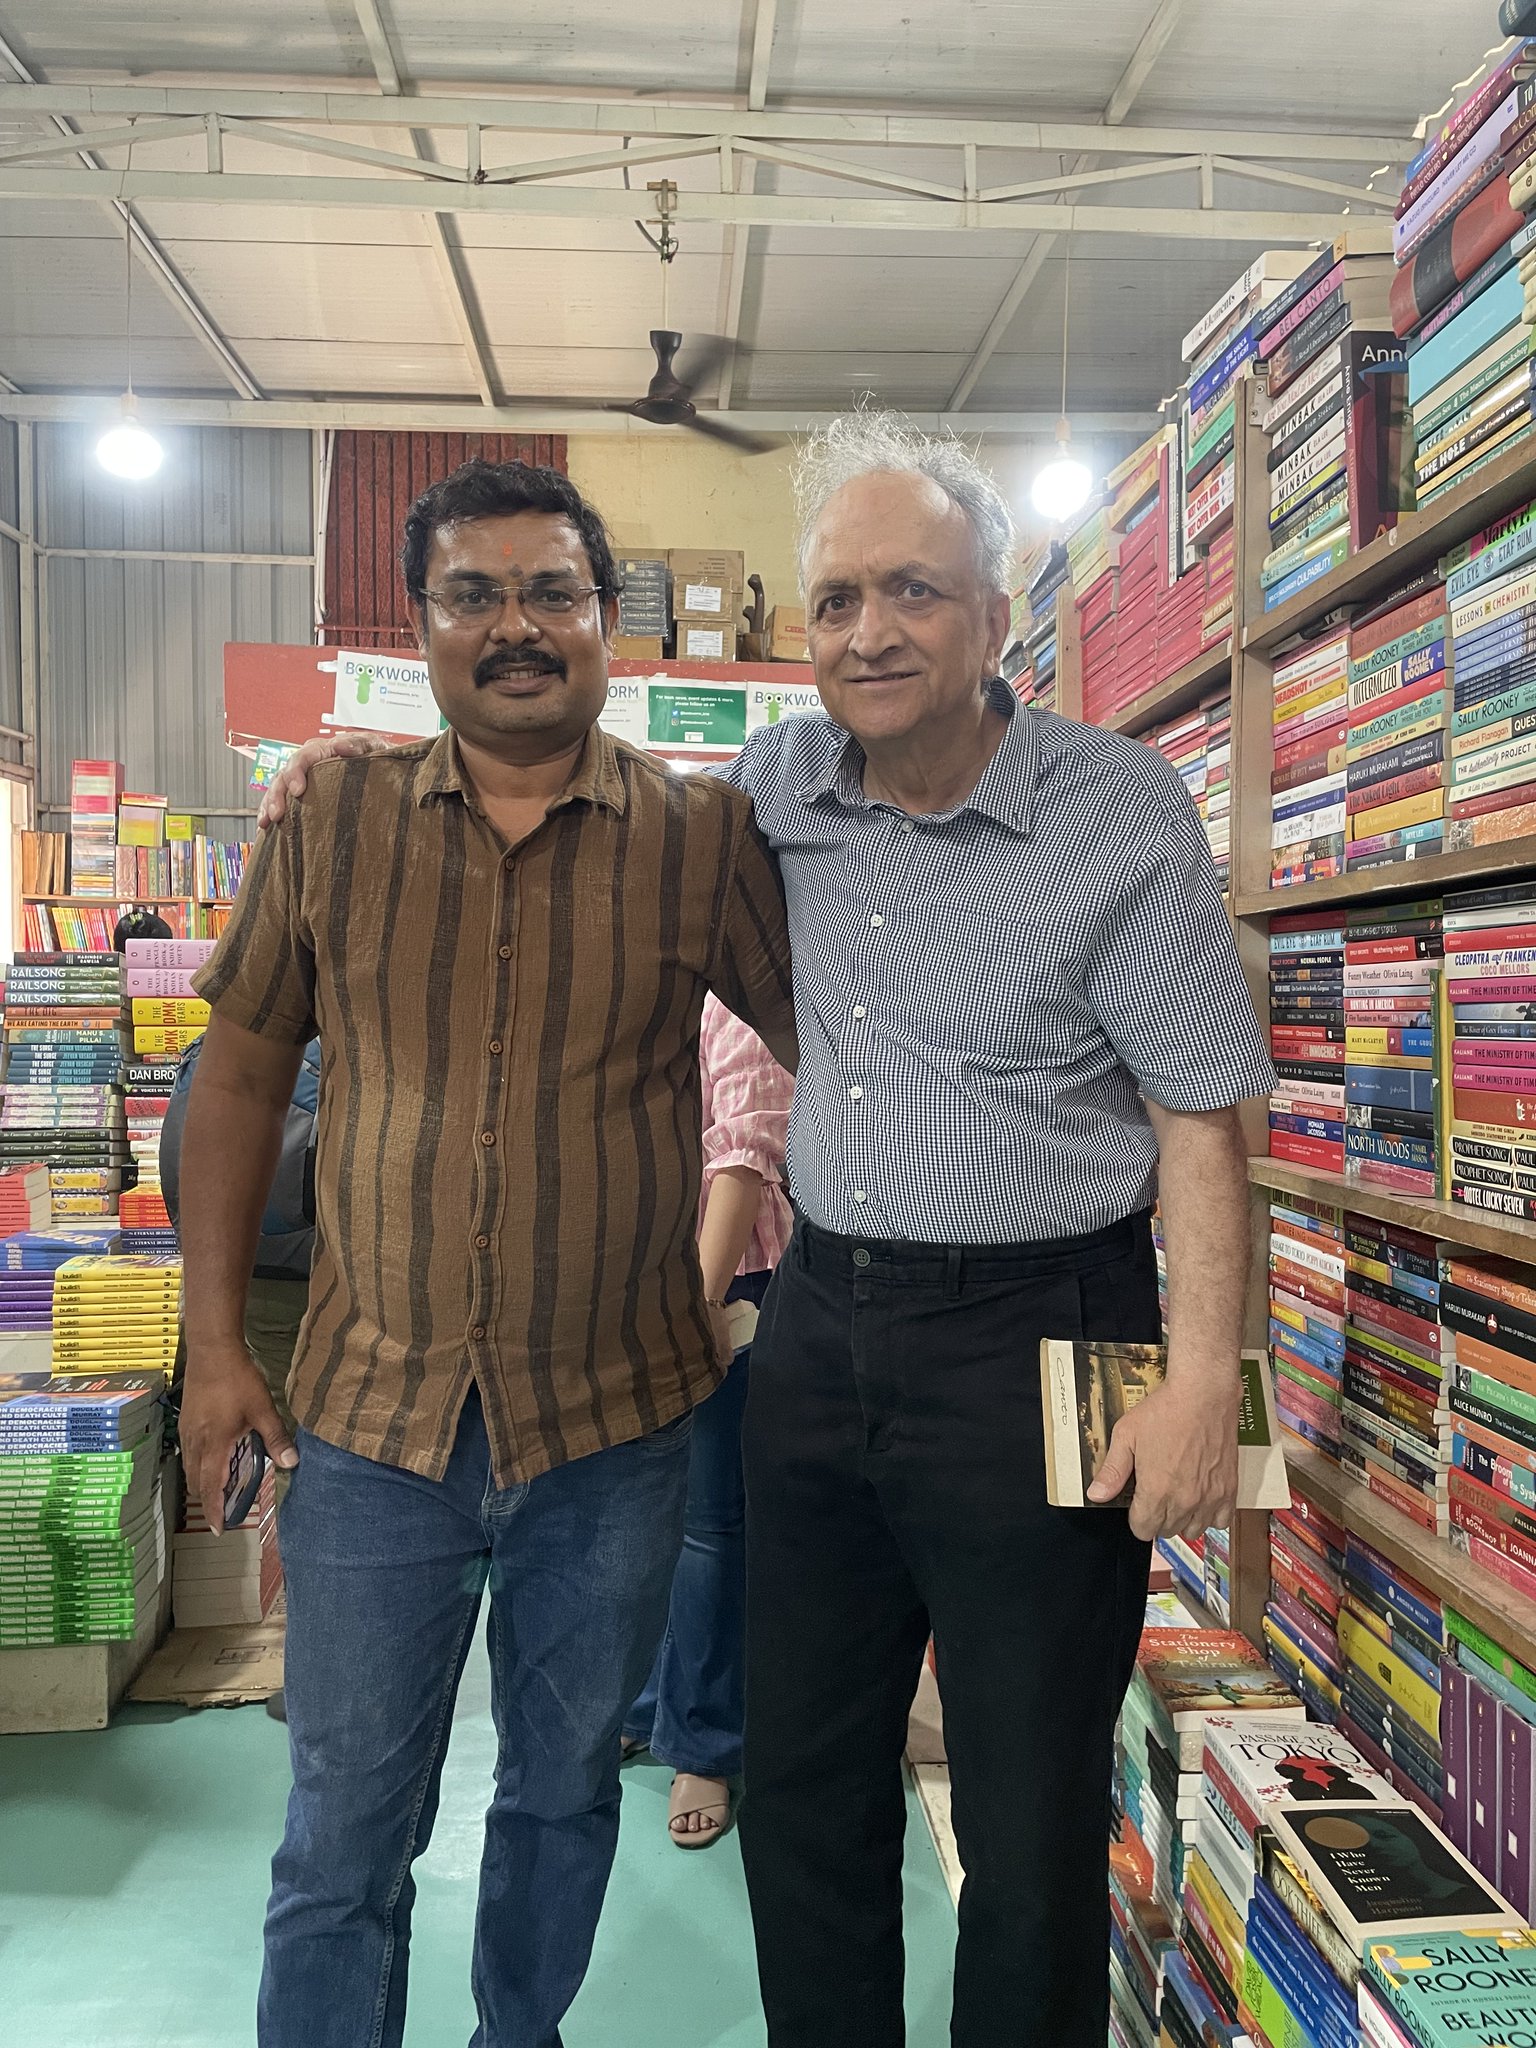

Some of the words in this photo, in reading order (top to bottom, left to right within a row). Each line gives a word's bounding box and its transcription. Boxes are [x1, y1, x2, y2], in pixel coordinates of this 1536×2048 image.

[1279, 319, 1295, 336] BEL
[1297, 279, 1331, 318] CANTO
[1469, 378, 1485, 394] Moon
[1484, 365, 1499, 381] Glow
[1499, 343, 1529, 371] Bookshop
[1280, 400, 1316, 441] MINBAK
[1277, 442, 1312, 482] MINBAK
[1419, 460, 1439, 482] THE
[1439, 437, 1466, 467] HOLE
[1278, 461, 1314, 500] MINBAK
[1187, 503, 1196, 521] BEST
[1196, 490, 1209, 511] OFFER
[1209, 478, 1220, 498] WINS
[1187, 522, 1196, 539] BEST
[1196, 510, 1209, 530] OFFER
[1209, 499, 1220, 518] WINS
[1480, 503, 1531, 549] Martyr!
[1296, 554, 1332, 587] CULPABILITY
[1451, 575, 1466, 595] EVIL
[1466, 562, 1480, 583] EYE
[1498, 539, 1515, 563] ETAF
[1517, 527, 1533, 551] RUM
[1456, 605, 1484, 629] LESSONS
[1492, 582, 1531, 611] CHEMISTRY
[1353, 659, 1371, 677] SALLY
[1371, 643, 1400, 666] ROONEY
[1404, 657, 1434, 682] ROONEY
[1407, 647, 1431, 668] SALLY
[345, 661, 429, 684] BOOKWORM
[1353, 664, 1397, 706] INTERMEZZO
[755, 691, 823, 707] BOOKWO
[1457, 708, 1480, 728] SALLY
[1481, 693, 1520, 721] ROONEY
[1351, 724, 1370, 743] SALLY
[1369, 712, 1399, 733] ROONEY
[1459, 733, 1480, 749] Richard
[1481, 726, 1509, 743] Flanagan
[1348, 765, 1369, 784] HARUKI
[1369, 756, 1399, 777] MURAKAMI
[1467, 751, 1499, 773] Authenticity
[1500, 742, 1531, 761] PROJECT
[1361, 787, 1381, 807] Naked
[1380, 781, 1401, 803] Light
[1455, 952, 1490, 967] CLEOPATRA
[1480, 964, 1498, 976] COCO
[1499, 963, 1530, 975] MELLORS
[1362, 969, 1381, 981] Weather
[1383, 969, 1398, 979] Olivia
[1398, 968, 1413, 980] Laing
[1449, 987, 1470, 996] KALIANE
[1470, 986, 1482, 996] THE
[1482, 985, 1511, 996] MINISTRY
[1512, 985, 1521, 995] OF
[152, 1006, 161, 1019] THE
[162, 1001, 177, 1024] DMK
[176, 1001, 186, 1024] YEARS
[164, 1029, 179, 1053] DMK
[1474, 1048, 1486, 1058] THE
[1486, 1049, 1514, 1059] MINISTRY
[1514, 1050, 1524, 1060] OF
[129, 1068, 152, 1081] DAN
[1453, 1073, 1473, 1082] KALIANE
[1474, 1074, 1486, 1084] THE
[1486, 1074, 1514, 1086] MINISTRY
[1514, 1075, 1523, 1086] OF
[1307, 1119, 1325, 1130] HOWARD
[1307, 1127, 1327, 1138] JACOBSON
[1347, 1133, 1375, 1154] NORTH
[1376, 1138, 1410, 1160] WOODS
[1411, 1153, 1428, 1165] MASON
[1454, 1140, 1486, 1158] PROPHET
[1485, 1144, 1507, 1161] SONG
[1517, 1149, 1536, 1166] PAUL
[1456, 1164, 1487, 1180] PROPHET
[1486, 1169, 1508, 1185] SONG
[1517, 1174, 1536, 1190] PAUL
[1483, 1189, 1503, 1212] LUCKY
[1502, 1192, 1525, 1217] SEVEN
[1473, 1275, 1500, 1297] Stationery
[1501, 1285, 1516, 1302] Shop
[1444, 1301, 1461, 1315] HARUKI
[1461, 1307, 1486, 1325] MURAKAMI
[1241, 1374, 1256, 1431] VICTORIAN
[1453, 1397, 1469, 1414] ALICE
[1469, 1405, 1493, 1424] MUNRO
[1477, 1453, 1489, 1467] The
[1490, 1458, 1513, 1480] Broom
[1465, 1517, 1497, 1546] BOOKSHOP
[1148, 1638, 1236, 1649] Stationery
[1176, 1646, 1221, 1657] Shop
[1171, 1660, 1240, 1669] Tehran
[1238, 1733, 1301, 1744] PASSAGE
[1304, 1735, 1334, 1746] TO
[1230, 1743, 1362, 1764] TOKYO
[1217, 1795, 1239, 1832] LESS
[1334, 1859, 1366, 1867] Have
[1337, 1851, 1367, 1860] Who
[1341, 1867, 1376, 1875] Never
[1346, 1876, 1391, 1885] Known
[1353, 1884, 1383, 1893] Men
[1292, 1896, 1324, 1943] THIEF
[1420, 1944, 1511, 1967] SALLY
[1368, 1953, 1395, 1997] SALLY
[1393, 1988, 1437, 2048] ROONEY
[1472, 1995, 1502, 2004] NORMAL
